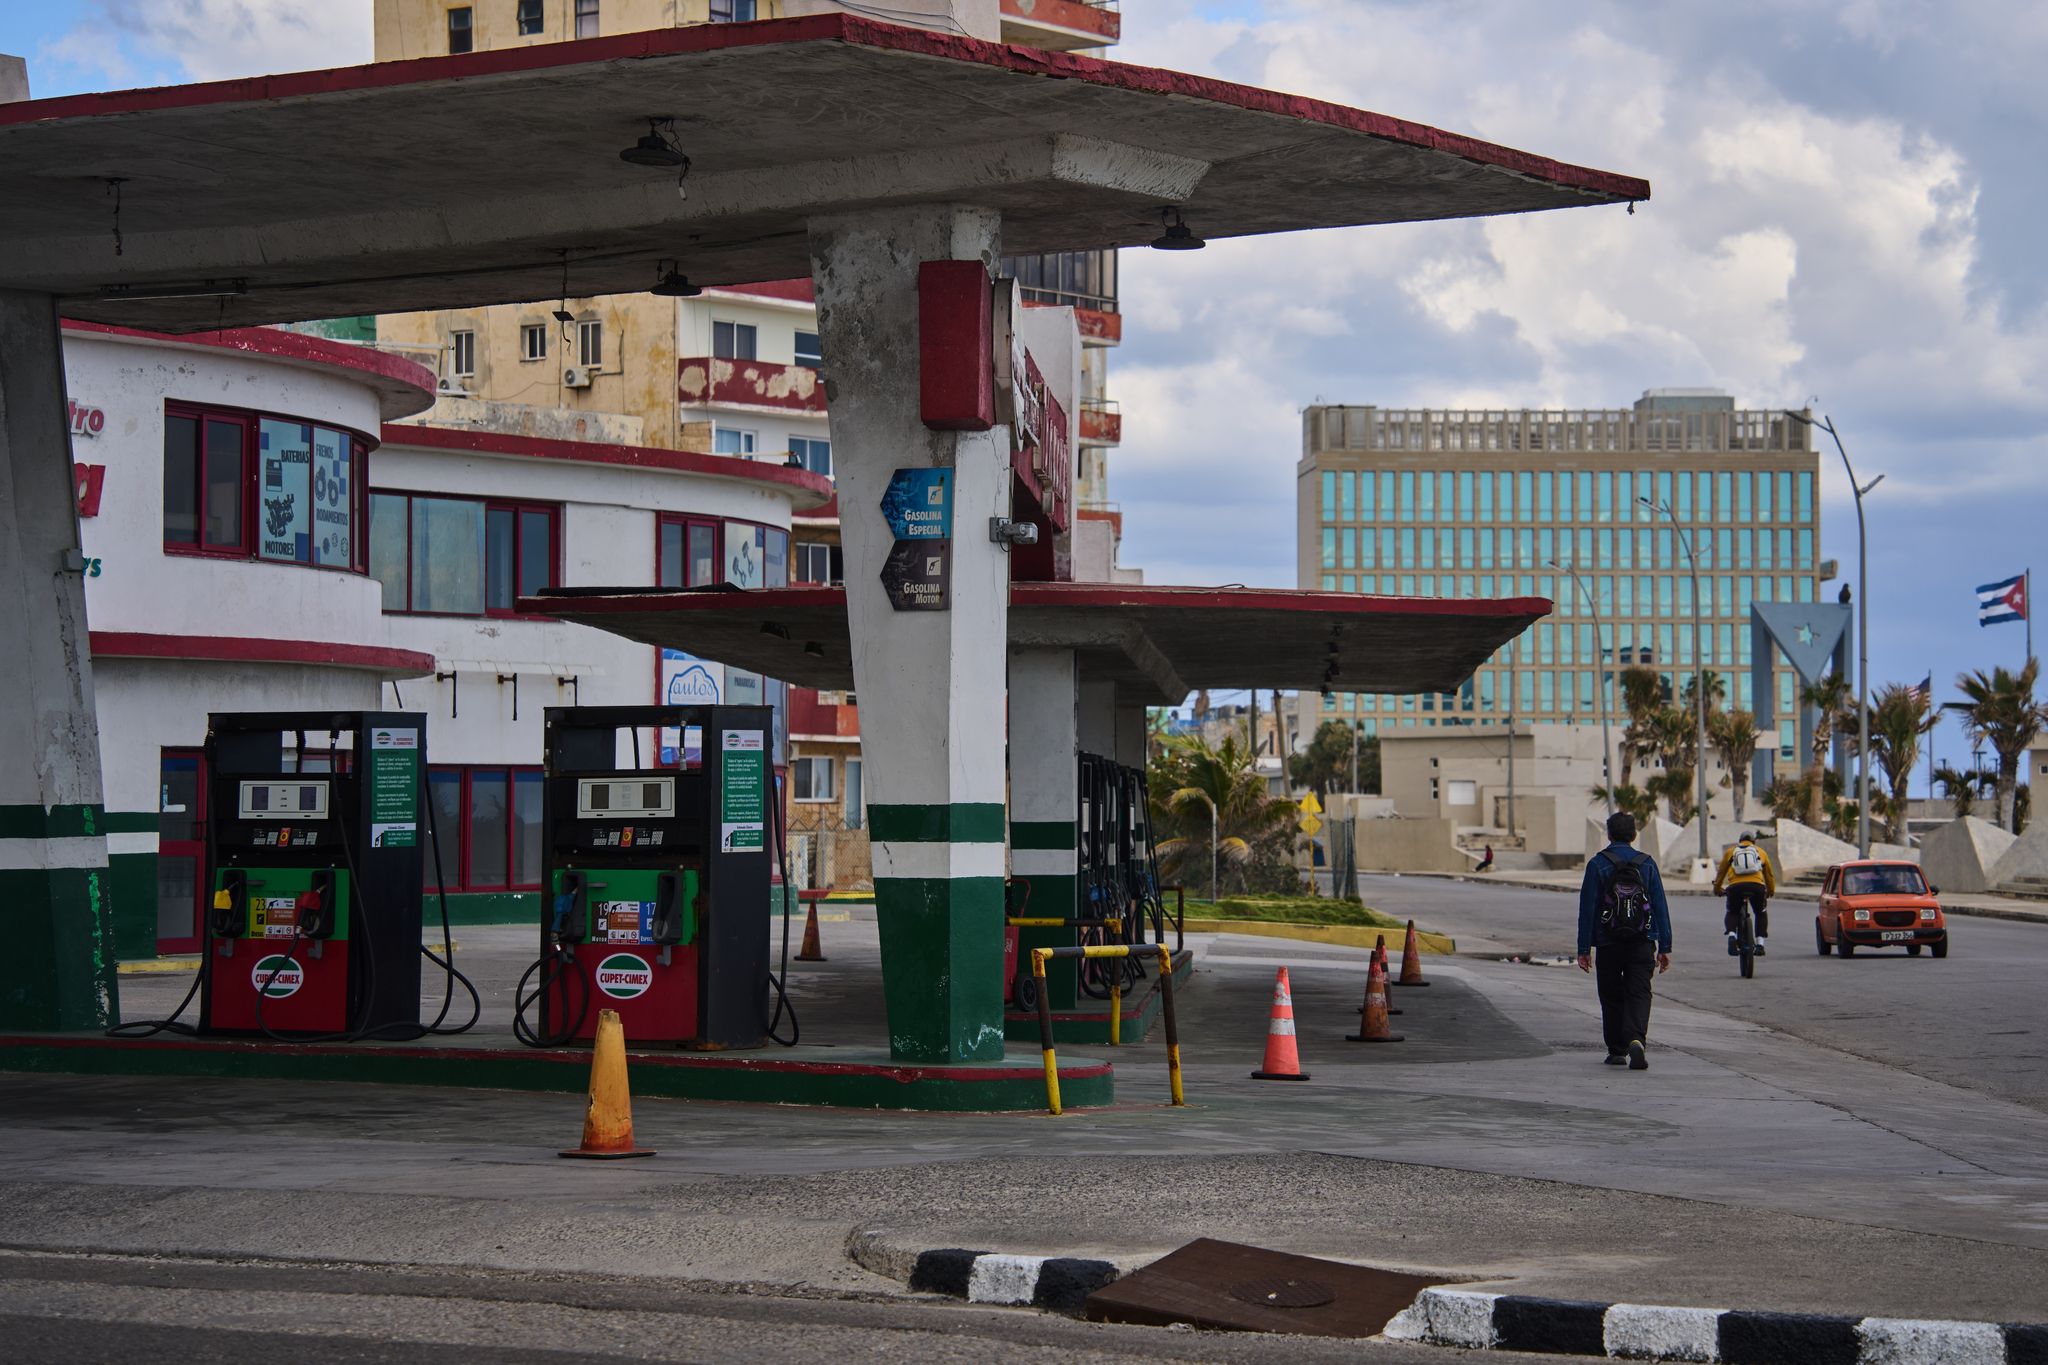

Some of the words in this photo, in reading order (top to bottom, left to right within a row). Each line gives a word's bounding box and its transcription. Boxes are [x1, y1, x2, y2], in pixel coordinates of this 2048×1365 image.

[281, 450, 310, 464] BATERIAS
[265, 540, 295, 556] MOTORES
[673, 674, 714, 697] autos
[256, 899, 266, 911] 23
[598, 902, 609, 916] 19
[646, 902, 657, 916] 17
[600, 973, 648, 985] CUPET-CIMEX
